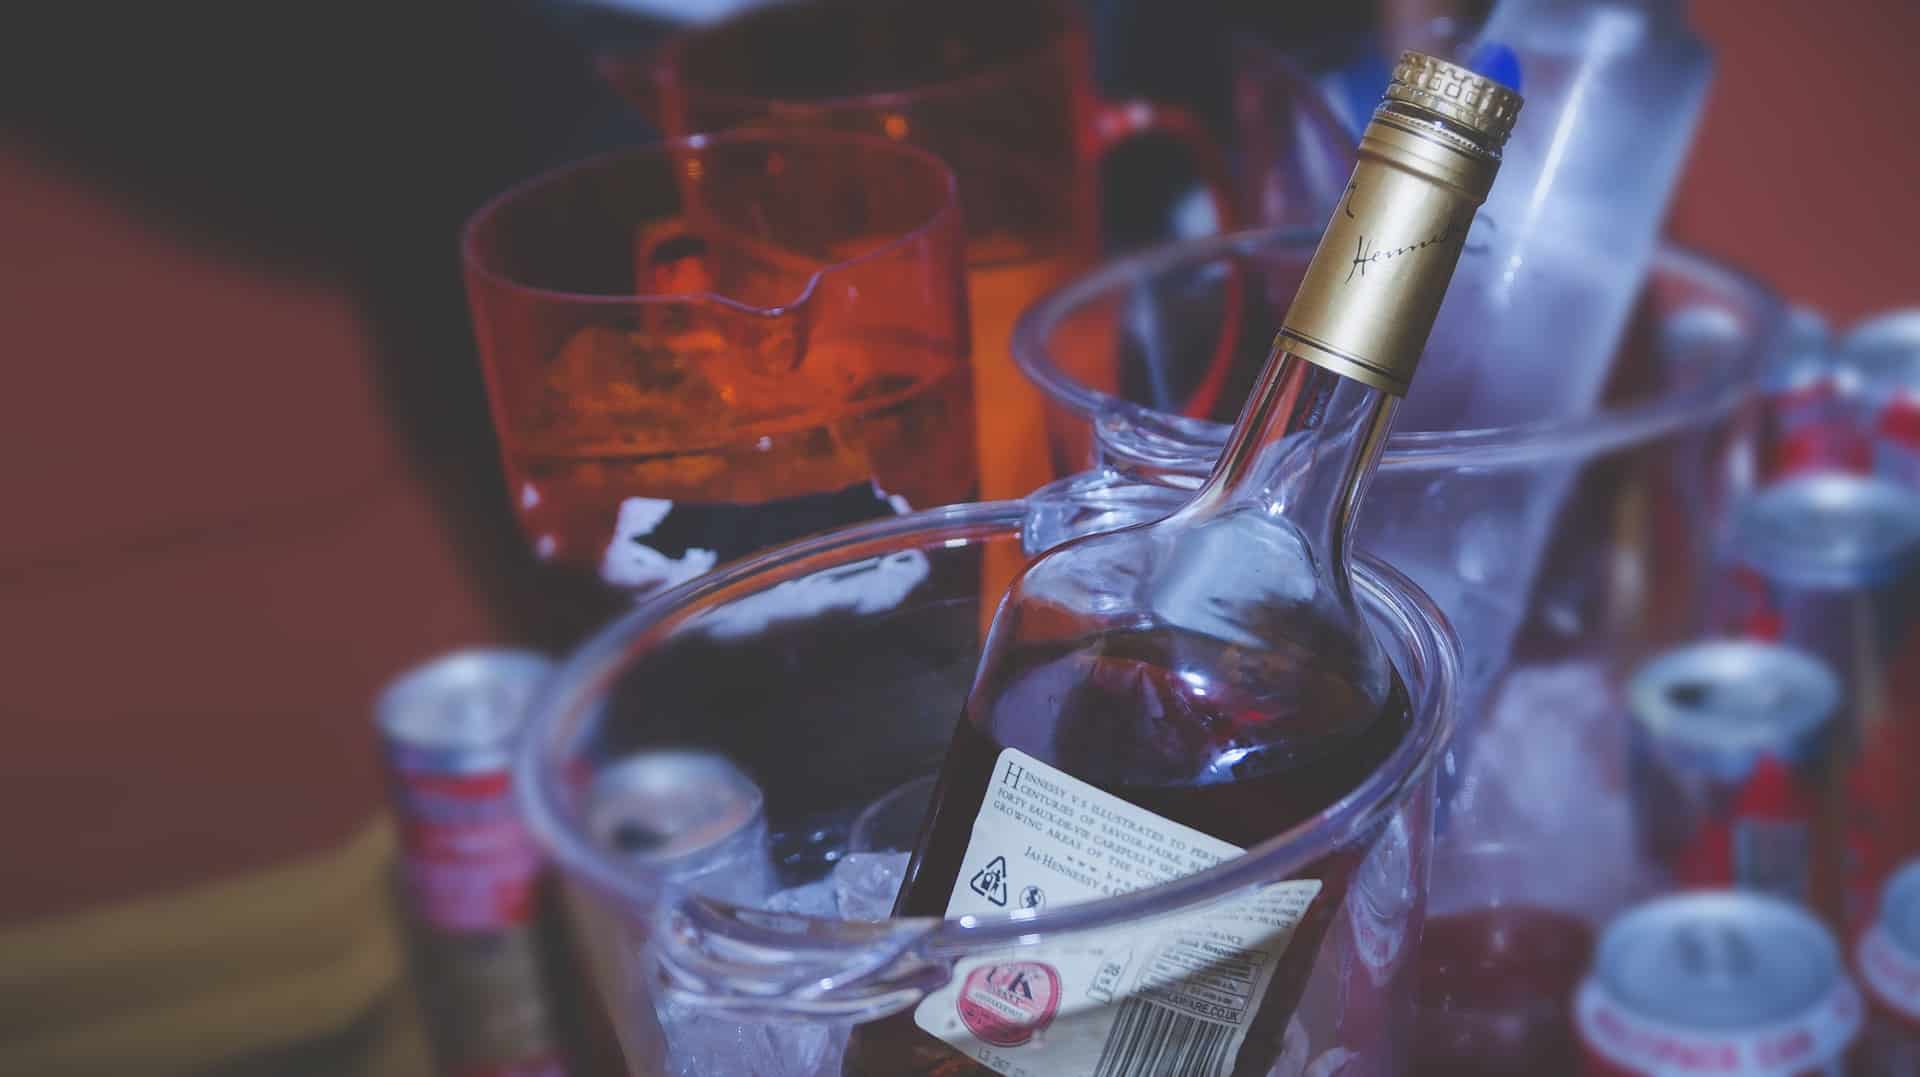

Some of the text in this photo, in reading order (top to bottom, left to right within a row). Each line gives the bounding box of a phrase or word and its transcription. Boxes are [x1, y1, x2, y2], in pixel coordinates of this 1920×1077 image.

[997, 788, 1026, 808] FORTY
[1019, 785, 1075, 817] CENTURIES
[1079, 814, 1095, 826] OF
[992, 800, 1043, 831] GROWING
[1046, 828, 1082, 849] AREAS
[1086, 846, 1102, 859] OF
[1108, 856, 1132, 872] THE
[1091, 804, 1164, 842] ILLUSTRATES
[1170, 839, 1185, 851] TO
